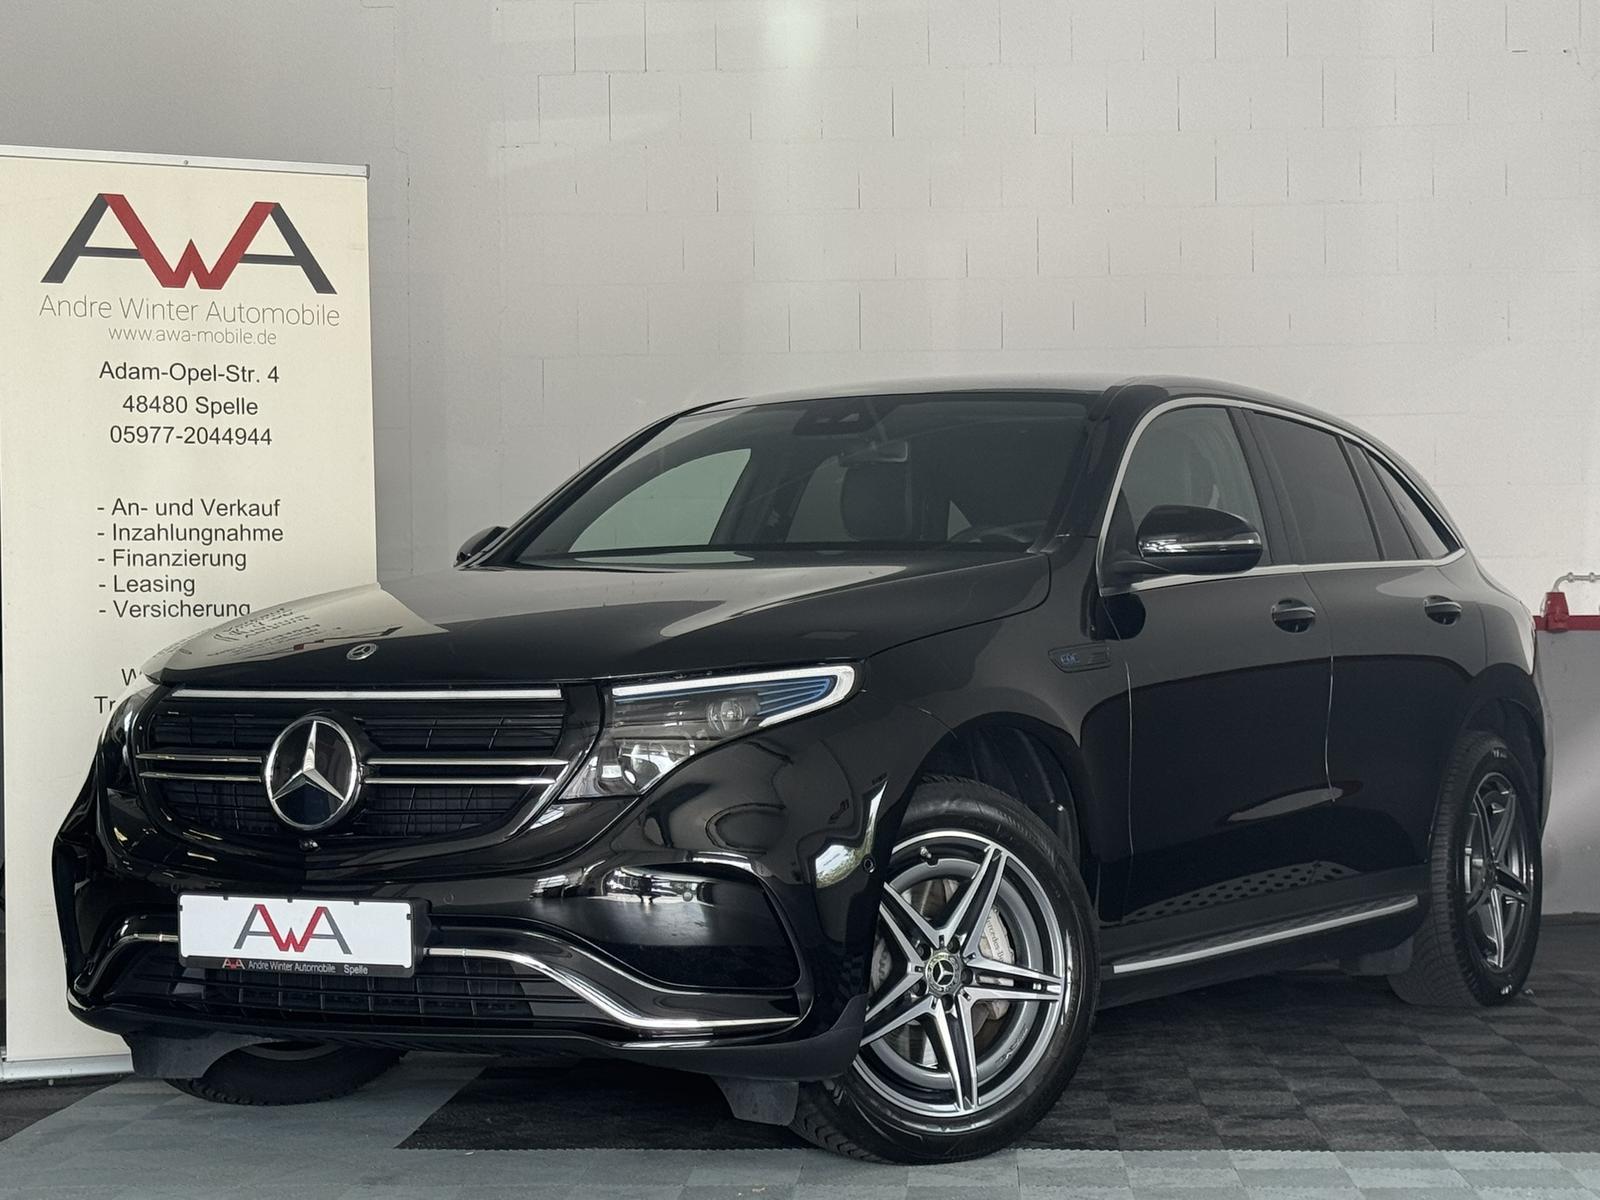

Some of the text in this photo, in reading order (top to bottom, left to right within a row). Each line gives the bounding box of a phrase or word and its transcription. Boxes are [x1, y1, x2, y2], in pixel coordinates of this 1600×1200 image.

[40, 193, 337, 294] AWA
[39, 295, 340, 327] Andre Winter Automobile
[108, 326, 277, 345] www.awa-mobile.de
[99, 361, 279, 386] Adam-Opel-Str. 4
[122, 393, 258, 419] 48480 Spelle
[110, 425, 272, 447] 05977-2044944
[111, 498, 148, 516] An-
[155, 498, 193, 516] und
[200, 498, 281, 517] Verkauf
[113, 523, 283, 546] Inzahlungnahme
[113, 549, 246, 571] Finanzierung
[113, 574, 195, 596] Leasing
[233, 904, 352, 954] AWA
[248, 960, 269, 970] Andre
[270, 962, 293, 972] Winter
[294, 963, 336, 973] Automobile
[343, 964, 369, 976] Spelle
